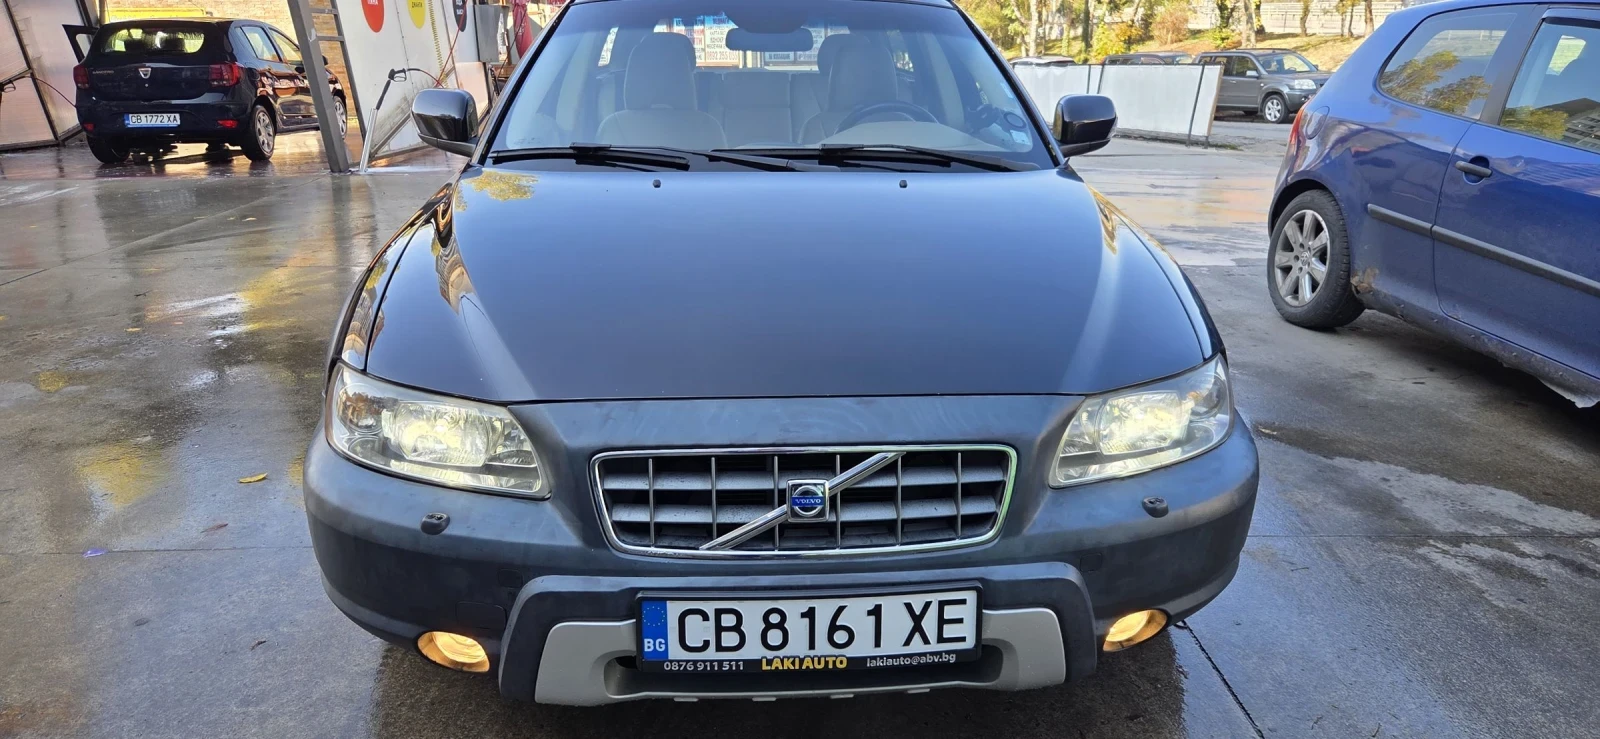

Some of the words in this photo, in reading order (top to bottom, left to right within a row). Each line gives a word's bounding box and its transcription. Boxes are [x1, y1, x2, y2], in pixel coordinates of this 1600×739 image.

[144, 115, 165, 124] 1772
[677, 607, 747, 653] CB
[760, 603, 883, 651] 8161
[902, 598, 967, 647] XE
[643, 638, 666, 652] BG
[663, 661, 695, 671] 0876
[697, 661, 719, 671] 911
[722, 661, 744, 671] 511
[761, 656, 800, 671] LAKI
[801, 655, 848, 670] AUTO
[866, 652, 956, 668] lakiauto@abv.bg
